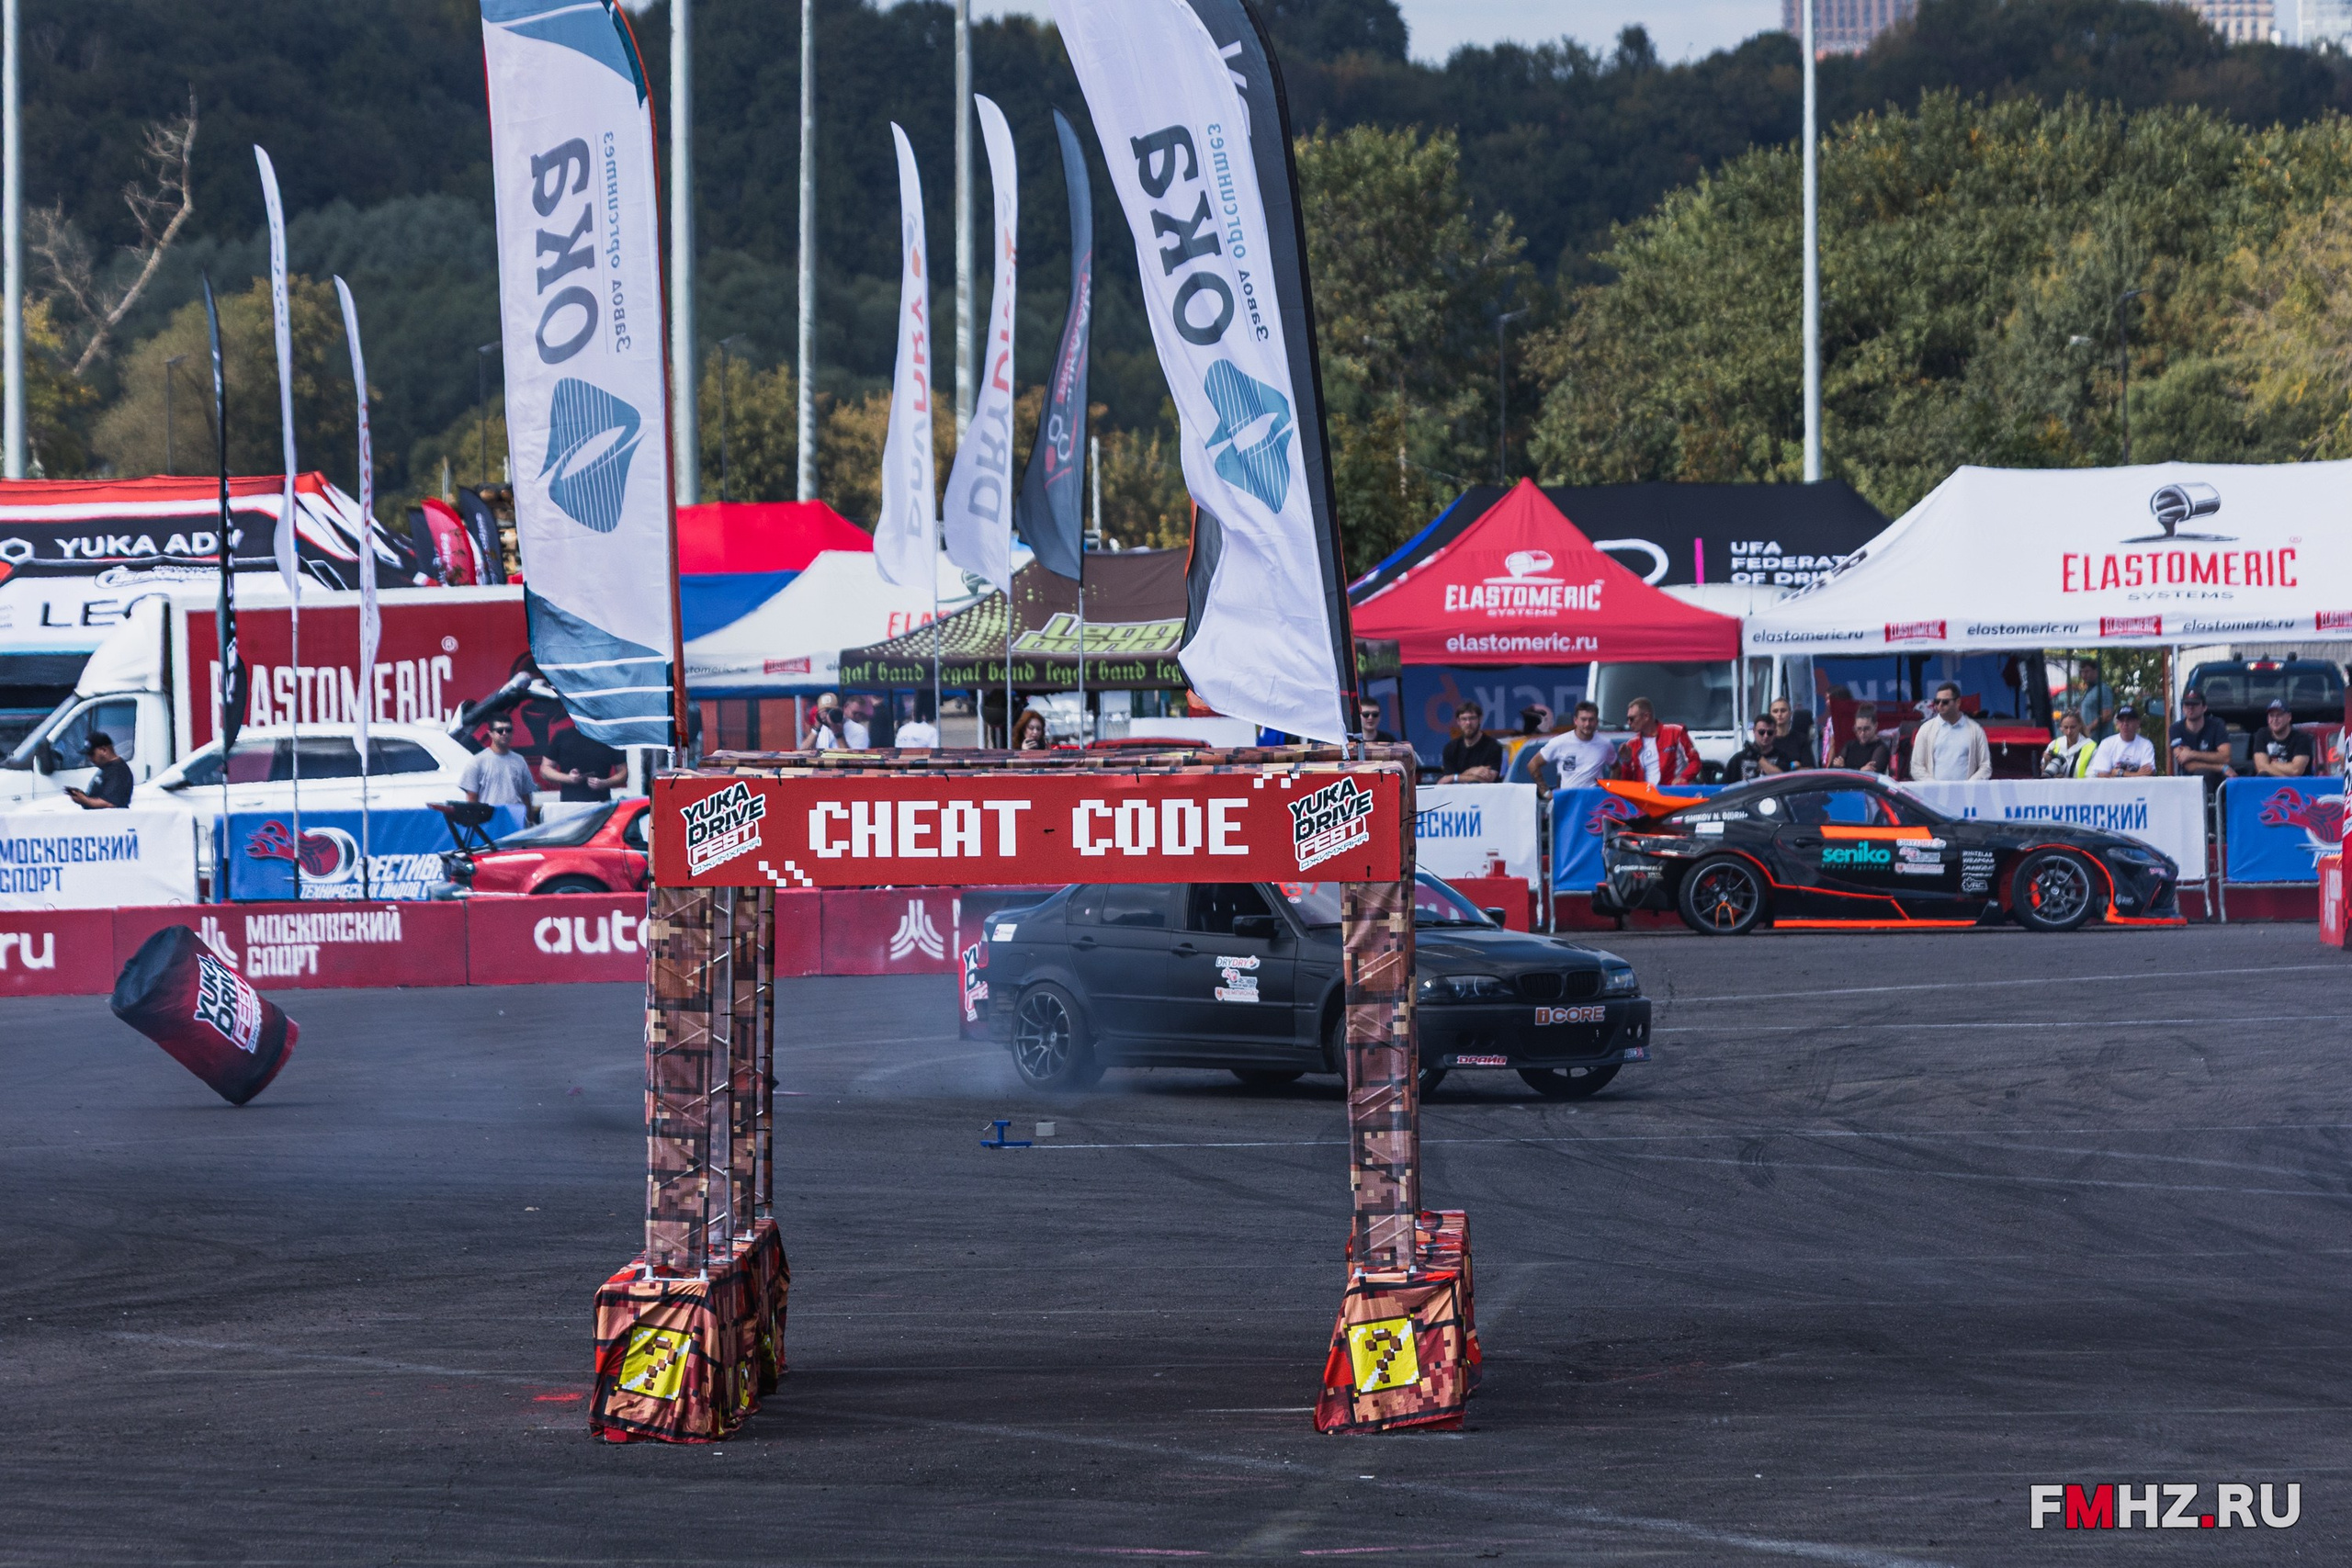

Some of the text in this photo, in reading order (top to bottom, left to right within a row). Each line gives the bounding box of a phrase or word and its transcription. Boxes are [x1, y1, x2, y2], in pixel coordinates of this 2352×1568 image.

[55, 534, 160, 558] YUKA
[1731, 540, 1782, 556] UFA
[1731, 554, 1849, 571] FEDERAT
[1731, 570, 1823, 585] OF DRI
[2062, 547, 2298, 593] ELASTOMERIC
[1444, 583, 1601, 613] ELASTOMERIC
[2128, 590, 2234, 601] SYSTEMS
[1487, 607, 1558, 618] SYSTEMS
[1445, 631, 1599, 653] elastomeric.ru
[1752, 628, 1864, 643] elastomeric.ru
[1966, 621, 2079, 636] elastomeric.ru
[2183, 617, 2295, 632] elastomeric.ru
[840, 660, 872, 685] gal
[877, 660, 924, 682] band
[988, 660, 1036, 682] band
[1098, 659, 1147, 681] band
[1156, 658, 1182, 685] leg
[209, 654, 453, 740] EASTOMERIC
[683, 783, 750, 826] YUKA
[1289, 778, 1358, 822] YUKA
[688, 795, 764, 848] DRIVE
[808, 797, 1250, 858] CHEAT CODE
[1295, 791, 1372, 843] DRIVE
[1415, 805, 1482, 838] ВСКИЙ
[0, 829, 140, 864] МОСКОВСКИЙ
[693, 821, 755, 865] FEST
[1299, 816, 1362, 860] FEST
[1822, 840, 1892, 864] seniko
[0, 866, 63, 893] СПОРТ
[245, 905, 402, 944] МОСКОВСКИЙ
[247, 945, 320, 977] СПОРТ
[1216, 957, 1249, 966] DRYDRY
[194, 954, 220, 1021] YUKA
